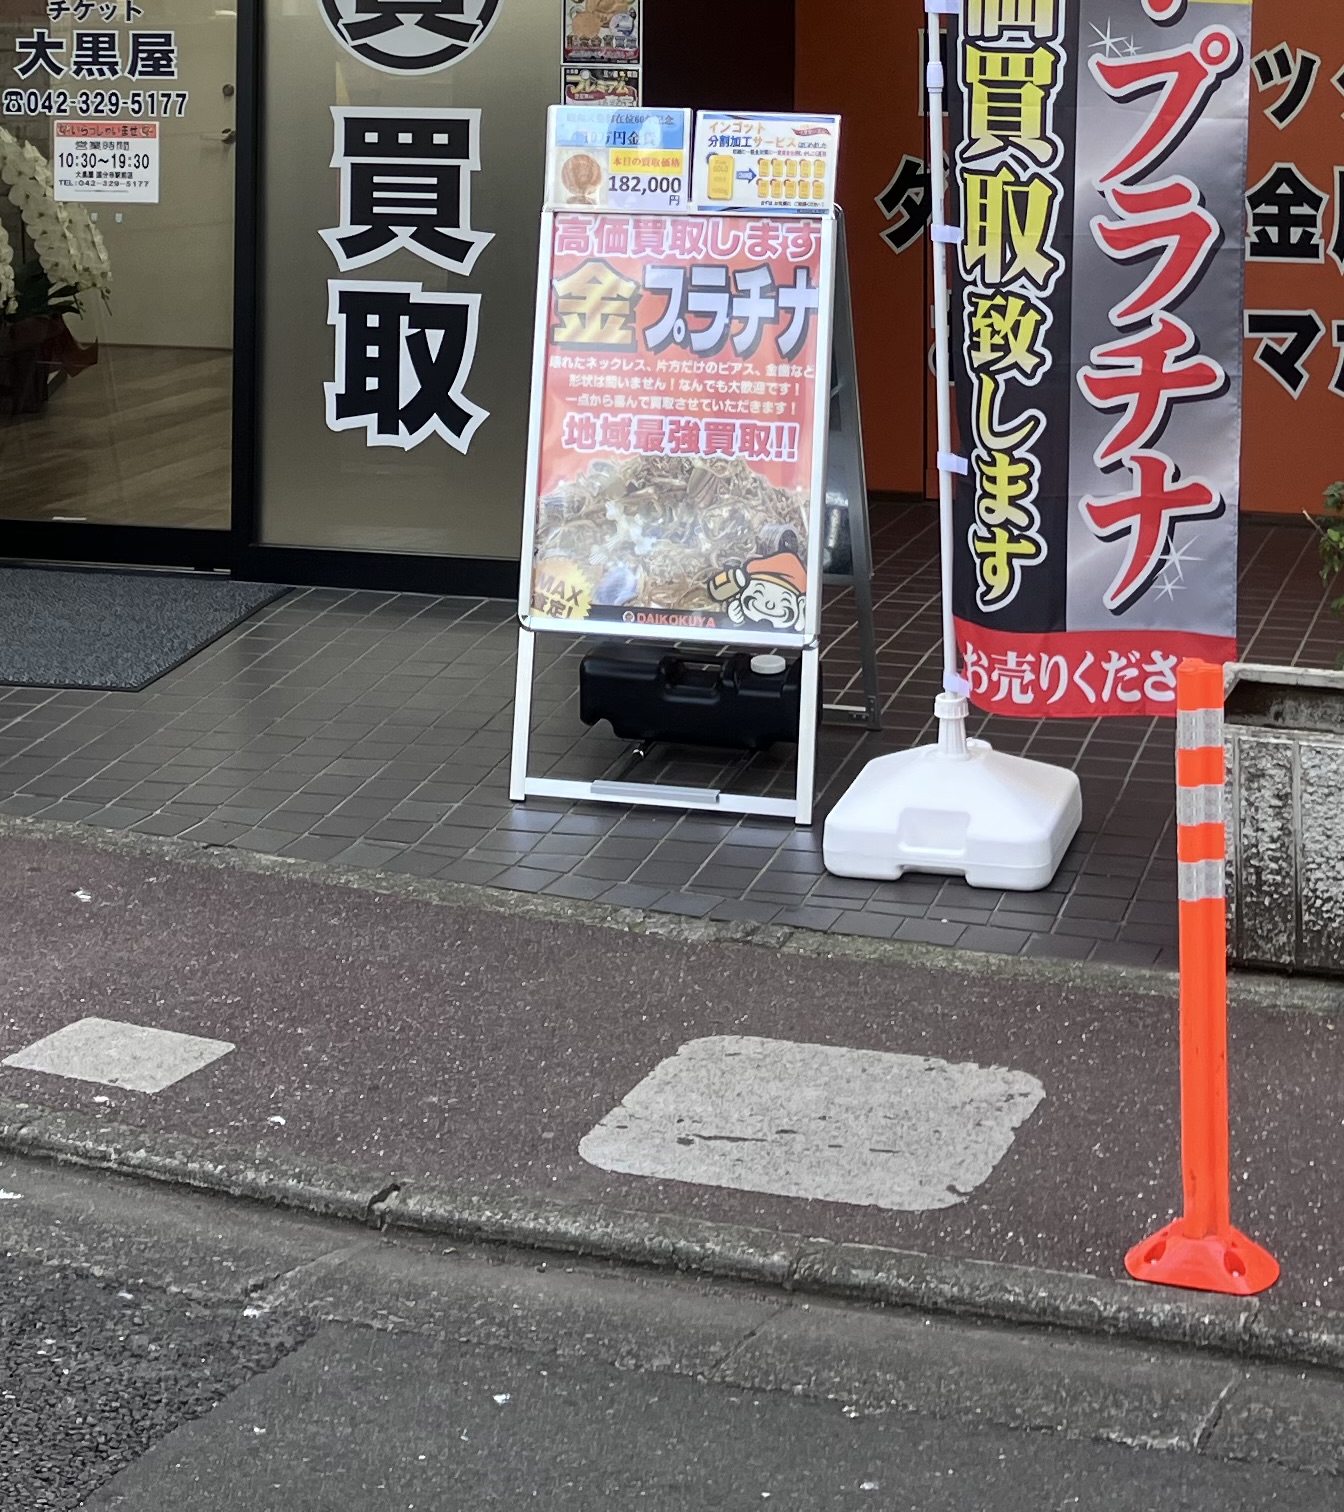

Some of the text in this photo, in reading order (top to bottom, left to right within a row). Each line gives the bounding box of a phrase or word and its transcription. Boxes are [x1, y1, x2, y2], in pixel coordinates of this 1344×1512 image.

[13, 28, 178, 81] 大黒屋
[25, 89, 189, 118] 042-329-5177
[708, 122, 766, 135] インゴット
[612, 156, 681, 168] 本日の買取価格
[608, 175, 682, 196] 182,000
[668, 194, 680, 206] 円
[554, 214, 822, 262] 高価買取します
[318, 105, 496, 455] 買取
[537, 571, 584, 606] MAX
[636, 611, 717, 628] DAIKOKUYA
